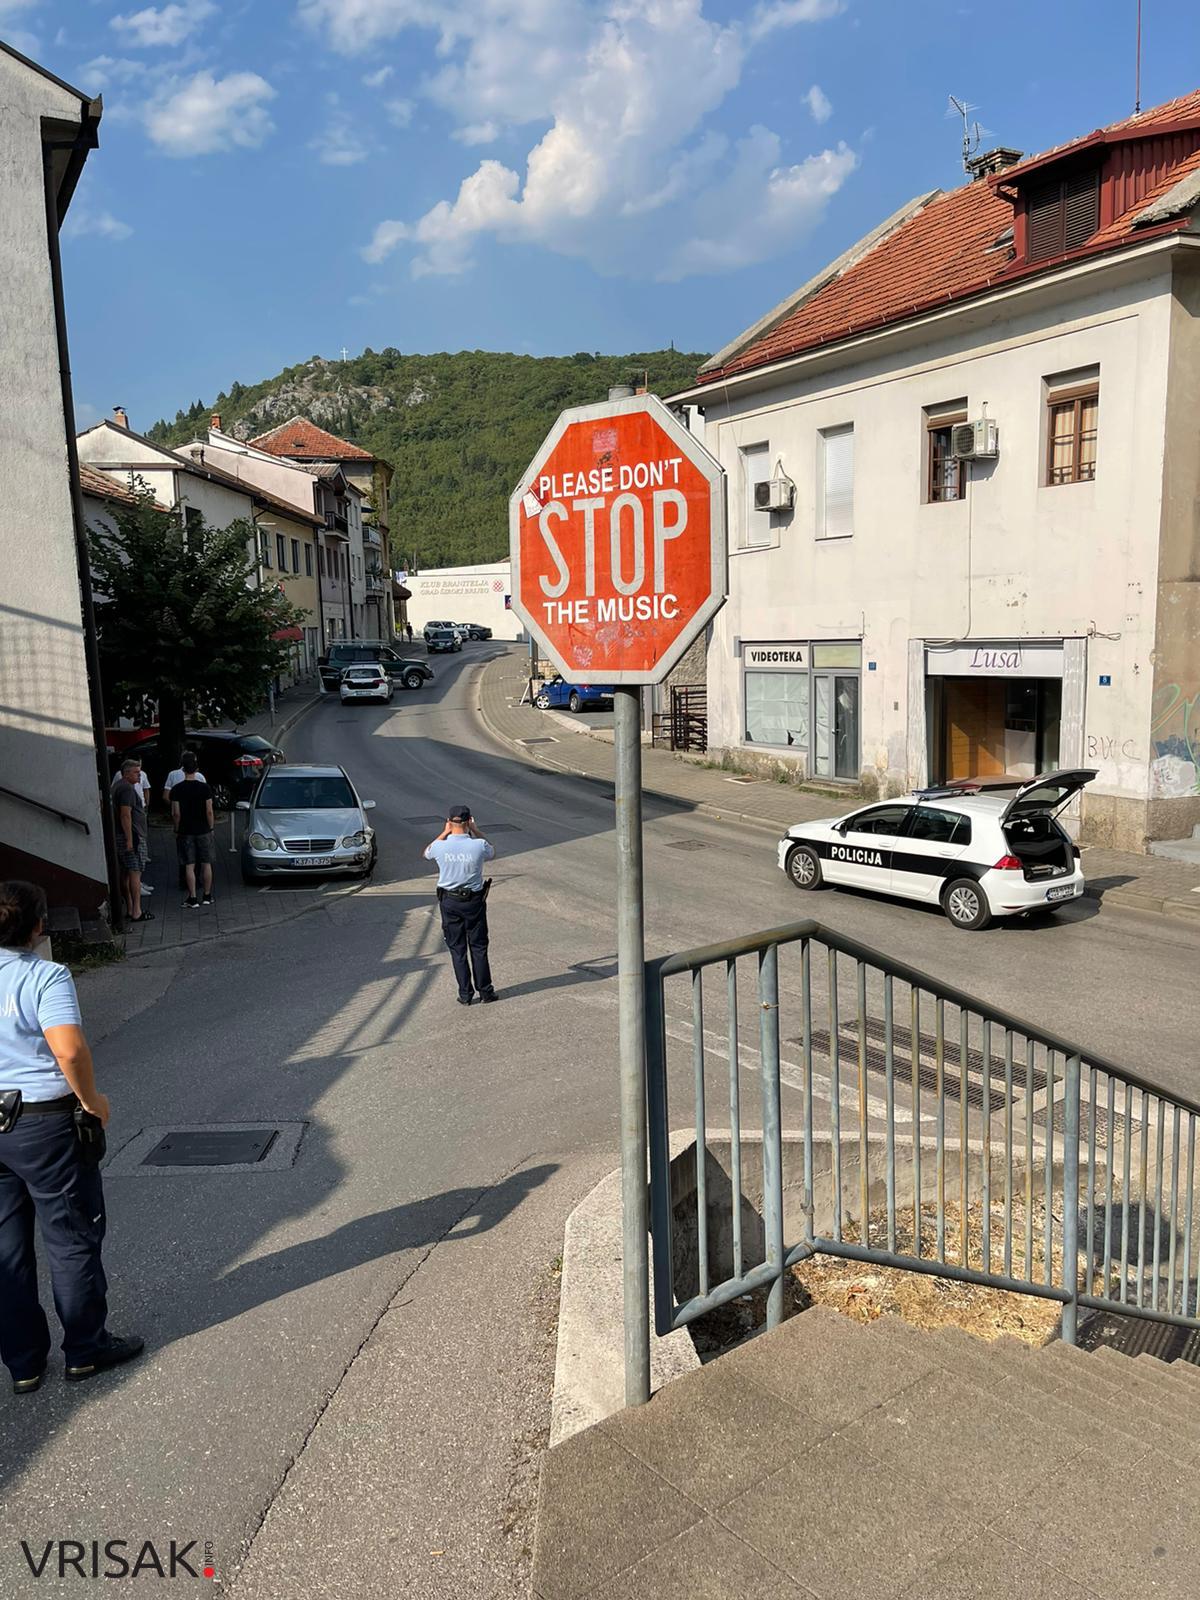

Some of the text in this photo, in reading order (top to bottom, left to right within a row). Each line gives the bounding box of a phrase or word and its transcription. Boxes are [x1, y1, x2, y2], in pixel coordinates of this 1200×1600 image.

[539, 458, 683, 499] PLEASE DON'T
[538, 488, 688, 599] STOP
[543, 594, 680, 625] THE MUSIC
[751, 651, 803, 663] VIDEOTEKA
[970, 647, 1020, 668] Lusa
[831, 846, 882, 866] POLICIJA
